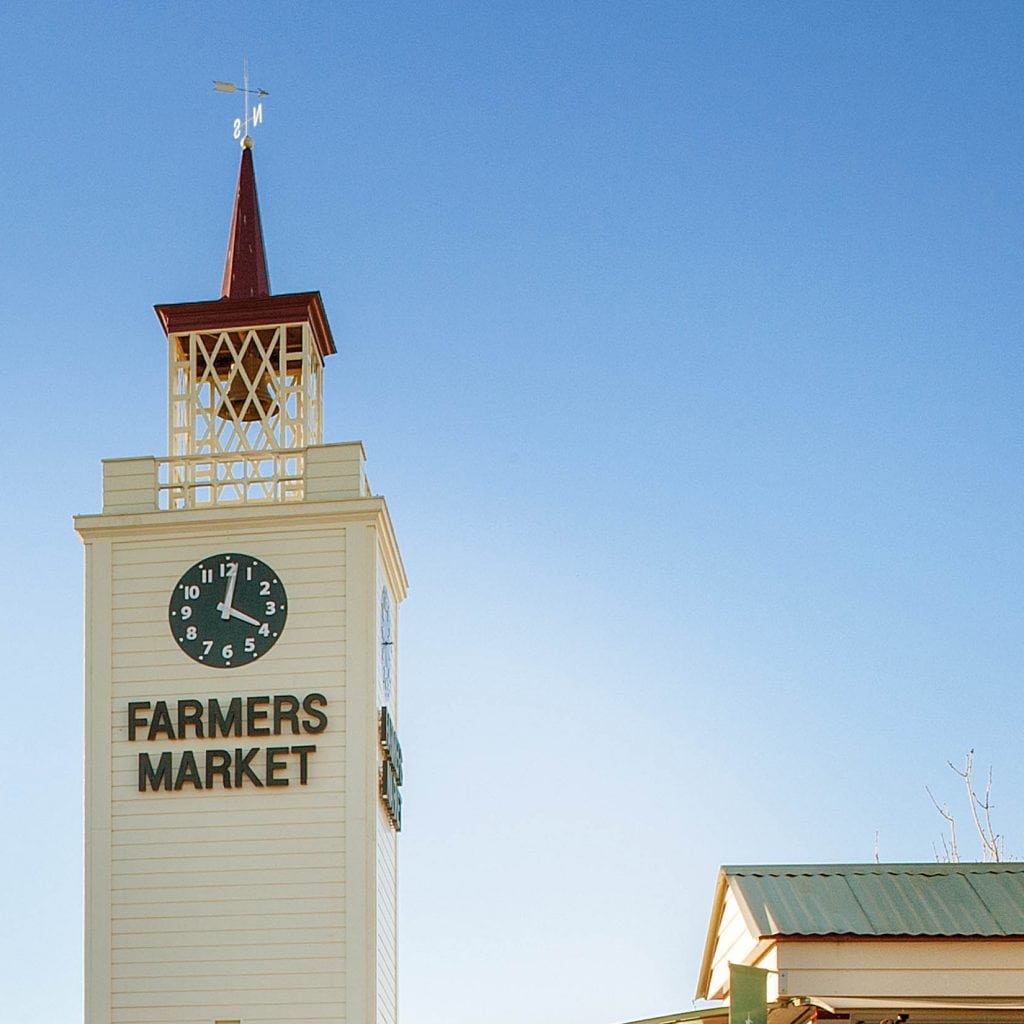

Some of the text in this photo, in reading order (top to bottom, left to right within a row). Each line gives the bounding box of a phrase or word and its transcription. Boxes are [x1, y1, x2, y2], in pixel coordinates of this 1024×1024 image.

[201, 569, 213, 583] 11
[220, 563, 238, 577] 12
[247, 567, 252, 580] 1
[184, 585, 200, 600] 10
[259, 581, 271, 595] 2
[180, 605, 192, 620] 9
[265, 601, 276, 615] 3
[186, 626, 197, 640] 8
[258, 623, 270, 637] 4
[202, 640, 213, 655] 7
[221, 644, 233, 659] 6
[244, 637, 256, 652] 5
[128, 693, 328, 741] FARMERS
[138, 745, 317, 792] MARKET
